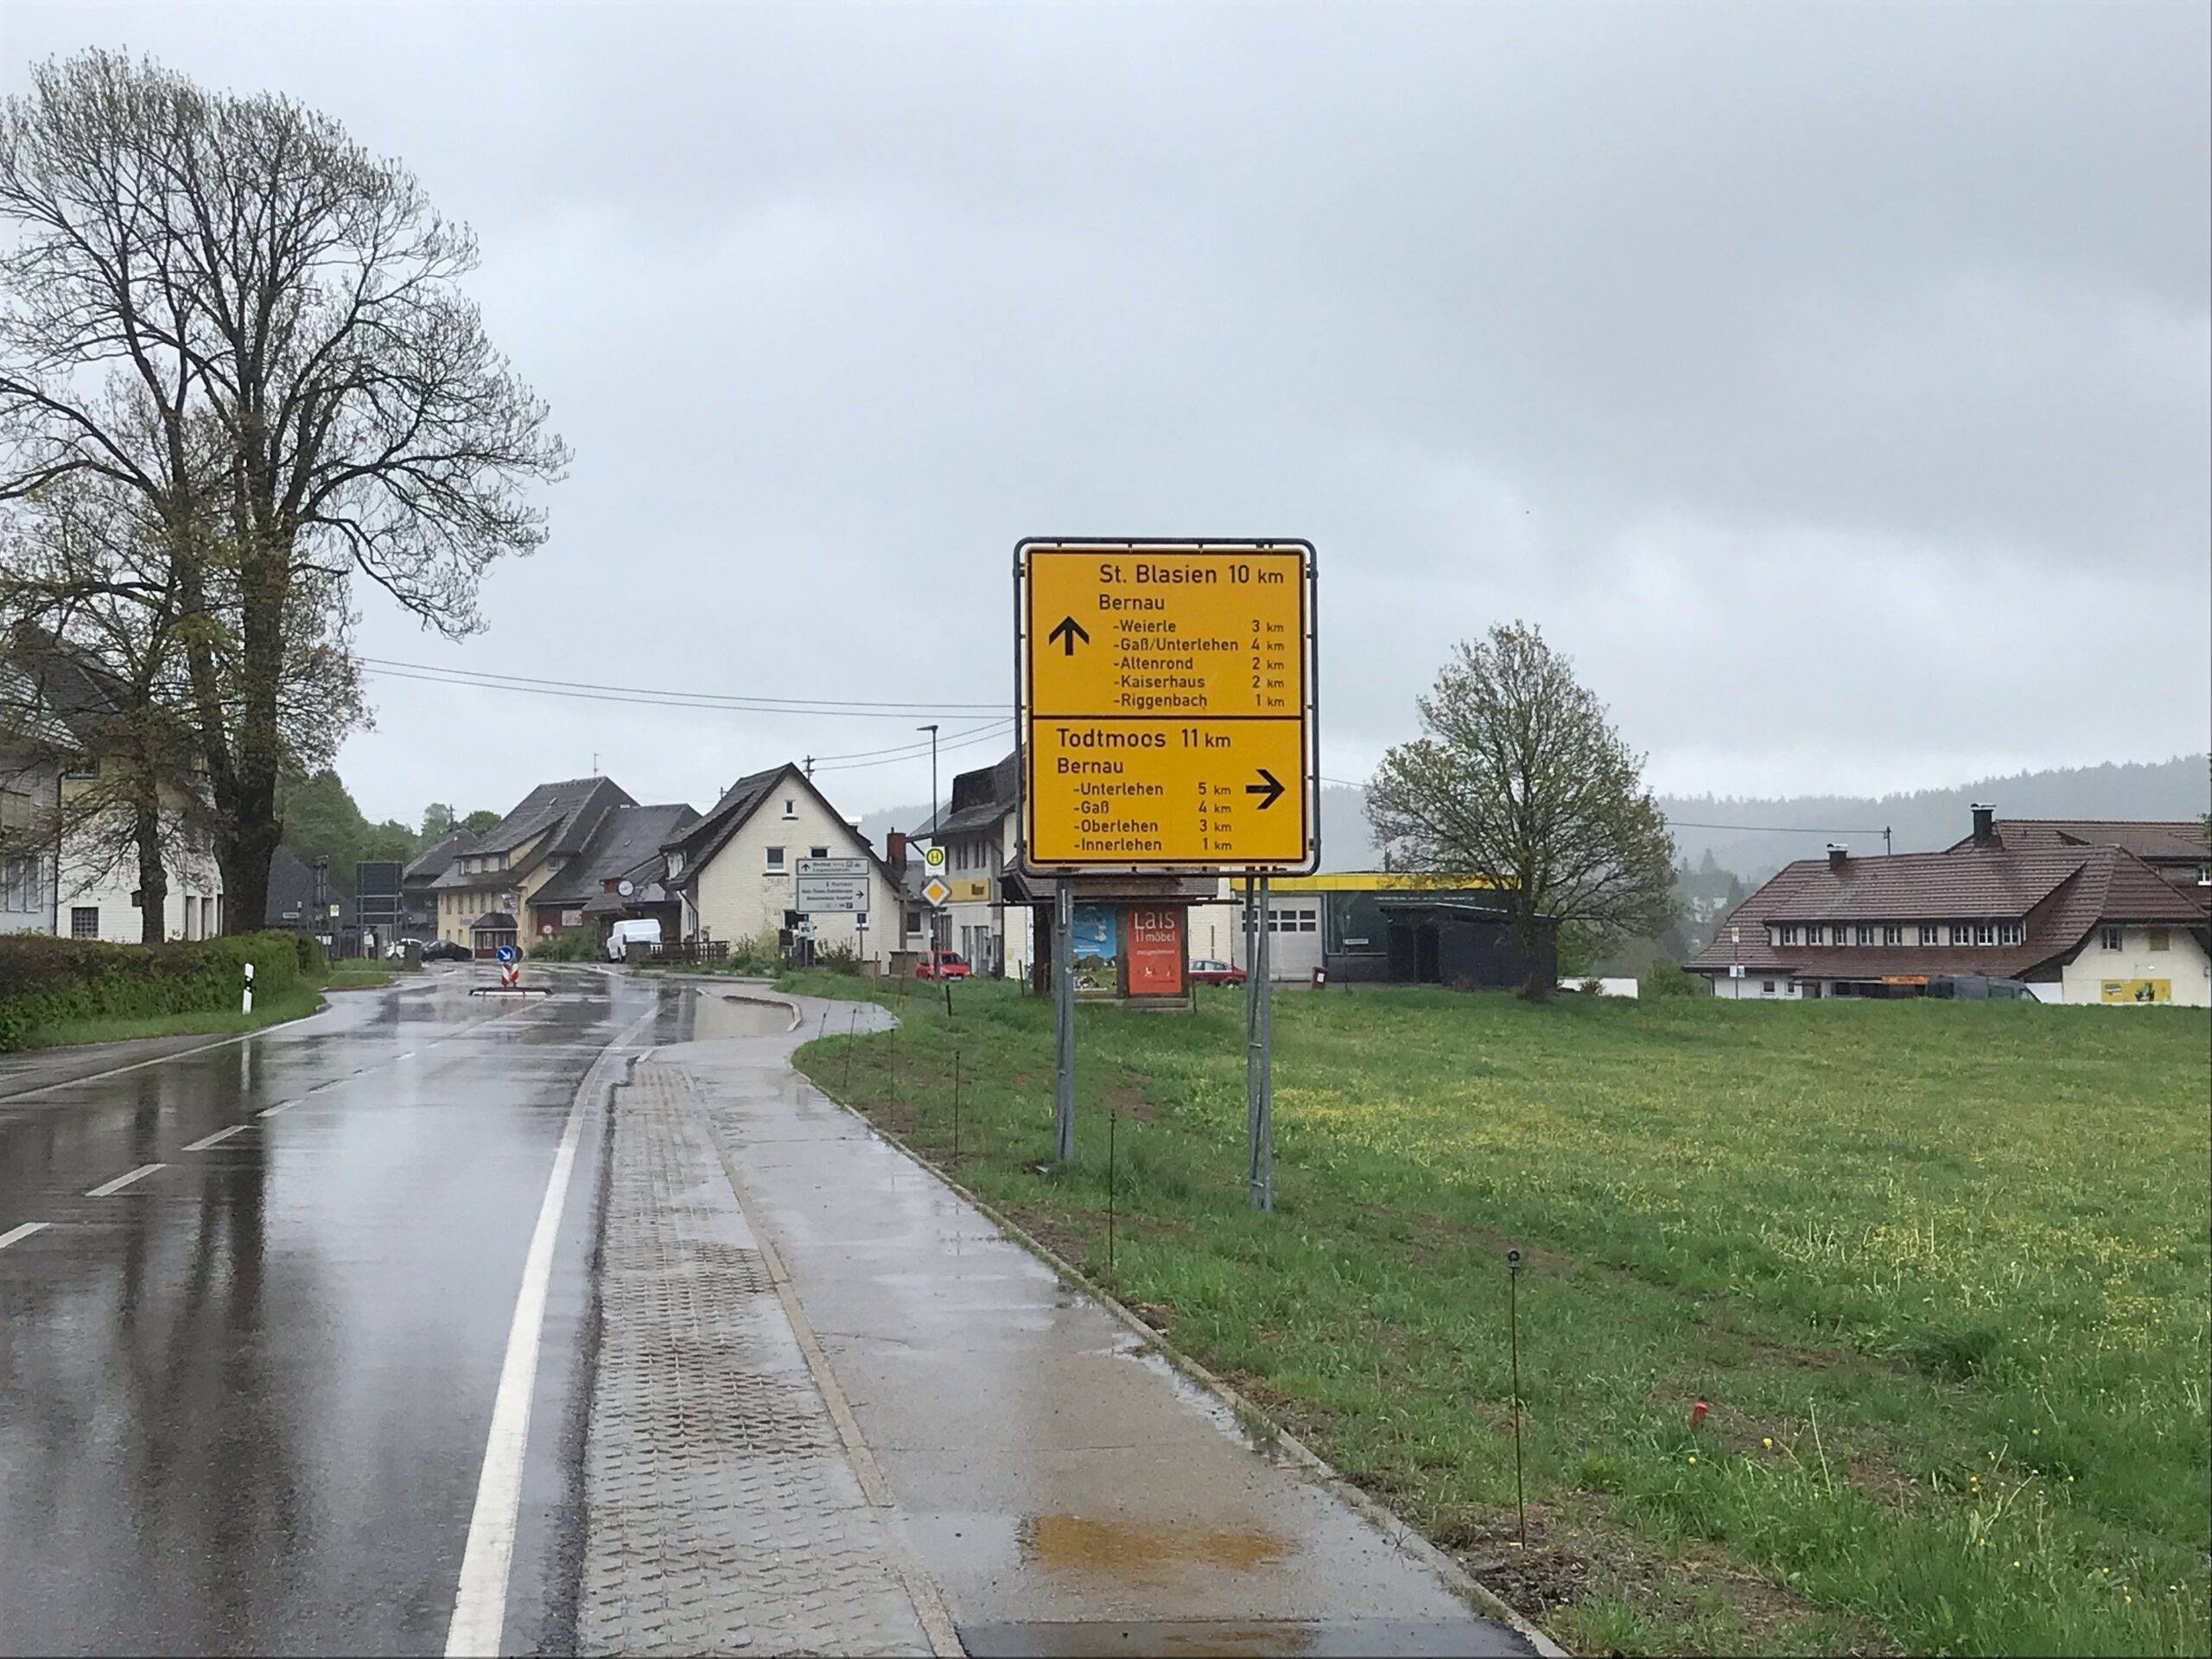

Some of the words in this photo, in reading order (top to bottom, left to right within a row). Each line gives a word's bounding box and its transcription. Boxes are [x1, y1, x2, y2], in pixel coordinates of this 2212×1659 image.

[1100, 564, 1127, 583] St.
[1136, 564, 1217, 583] Blasien
[1229, 565, 1249, 583] 10
[1257, 569, 1284, 583] km
[1100, 594, 1164, 610] Bernau
[1114, 620, 1176, 632] -Weierle
[1251, 620, 1261, 633] 3
[1266, 622, 1284, 632] km
[1114, 638, 1238, 651] -Gaß/Unterlehen
[1250, 638, 1260, 651] 4
[1267, 641, 1285, 651] km
[1114, 657, 1192, 670] -Altenrond
[1252, 657, 1261, 671] 2
[1267, 660, 1285, 670] km
[1114, 675, 1205, 688] -Kaiserhaus
[1251, 675, 1261, 689] 2
[1267, 679, 1285, 688] km
[1114, 693, 1207, 710] -Riggenbach
[1267, 696, 1285, 707] km
[1057, 728, 1166, 747] Todtmoos
[1182, 728, 1197, 747] 11
[1205, 733, 1231, 747] km
[1058, 758, 1123, 773] Bernau
[1073, 783, 1163, 795] -Unterlehen
[1198, 782, 1207, 796] 5
[1213, 785, 1232, 795] km
[1074, 800, 1109, 814] -Gaß
[1198, 800, 1207, 814] 4
[1213, 804, 1232, 813] km
[1074, 819, 1158, 832] -Oberlehen
[1199, 819, 1208, 833] 3
[1213, 822, 1232, 832] km
[1074, 837, 1161, 851] -Innerlehen
[1214, 842, 1232, 850] km
